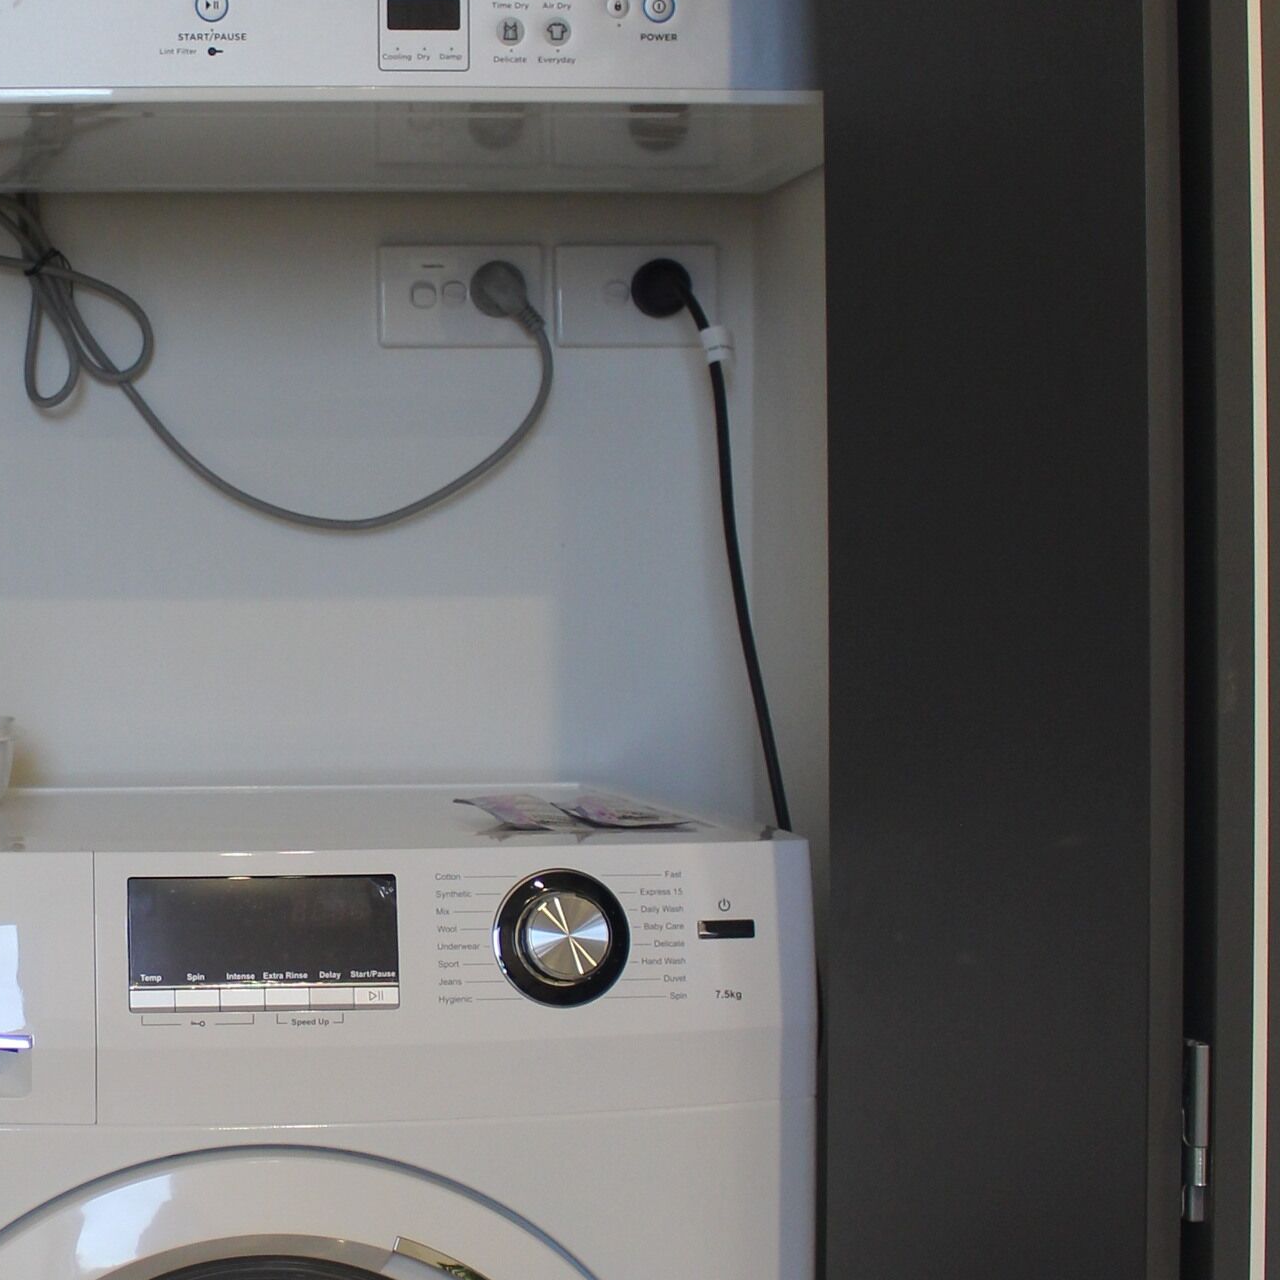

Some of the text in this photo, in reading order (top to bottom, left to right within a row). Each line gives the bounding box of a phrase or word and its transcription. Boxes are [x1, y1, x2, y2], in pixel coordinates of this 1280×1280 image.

[492, 1, 529, 11] Time Dry
[542, 1, 572, 11] Air Dry
[178, 32, 247, 41] START/PAUSE
[640, 33, 678, 42] POWER
[382, 53, 412, 61] Cooling
[417, 53, 430, 61] Dry
[439, 53, 462, 61] Damp
[493, 55, 528, 64] Delicate
[537, 55, 576, 65] Everyday
[435, 890, 472, 899] Synthetic
[640, 888, 671, 897] Express
[640, 905, 684, 914] Daily Wash
[644, 922, 684, 931] Baby Care
[437, 942, 480, 950] Underwear
[438, 960, 459, 968] Sport
[140, 974, 162, 983] Temp
[186, 973, 205, 982] Spin
[226, 972, 255, 981] Intense
[263, 971, 308, 980] Extra Rinse
[319, 971, 341, 980] Delay
[350, 970, 396, 978] Start/Pause
[438, 978, 462, 986] Jeans
[670, 992, 687, 1000] Spin
[715, 990, 742, 1000] 7.5kg
[438, 996, 472, 1005] Hygienic
[291, 1018, 330, 1027] Speed Up
